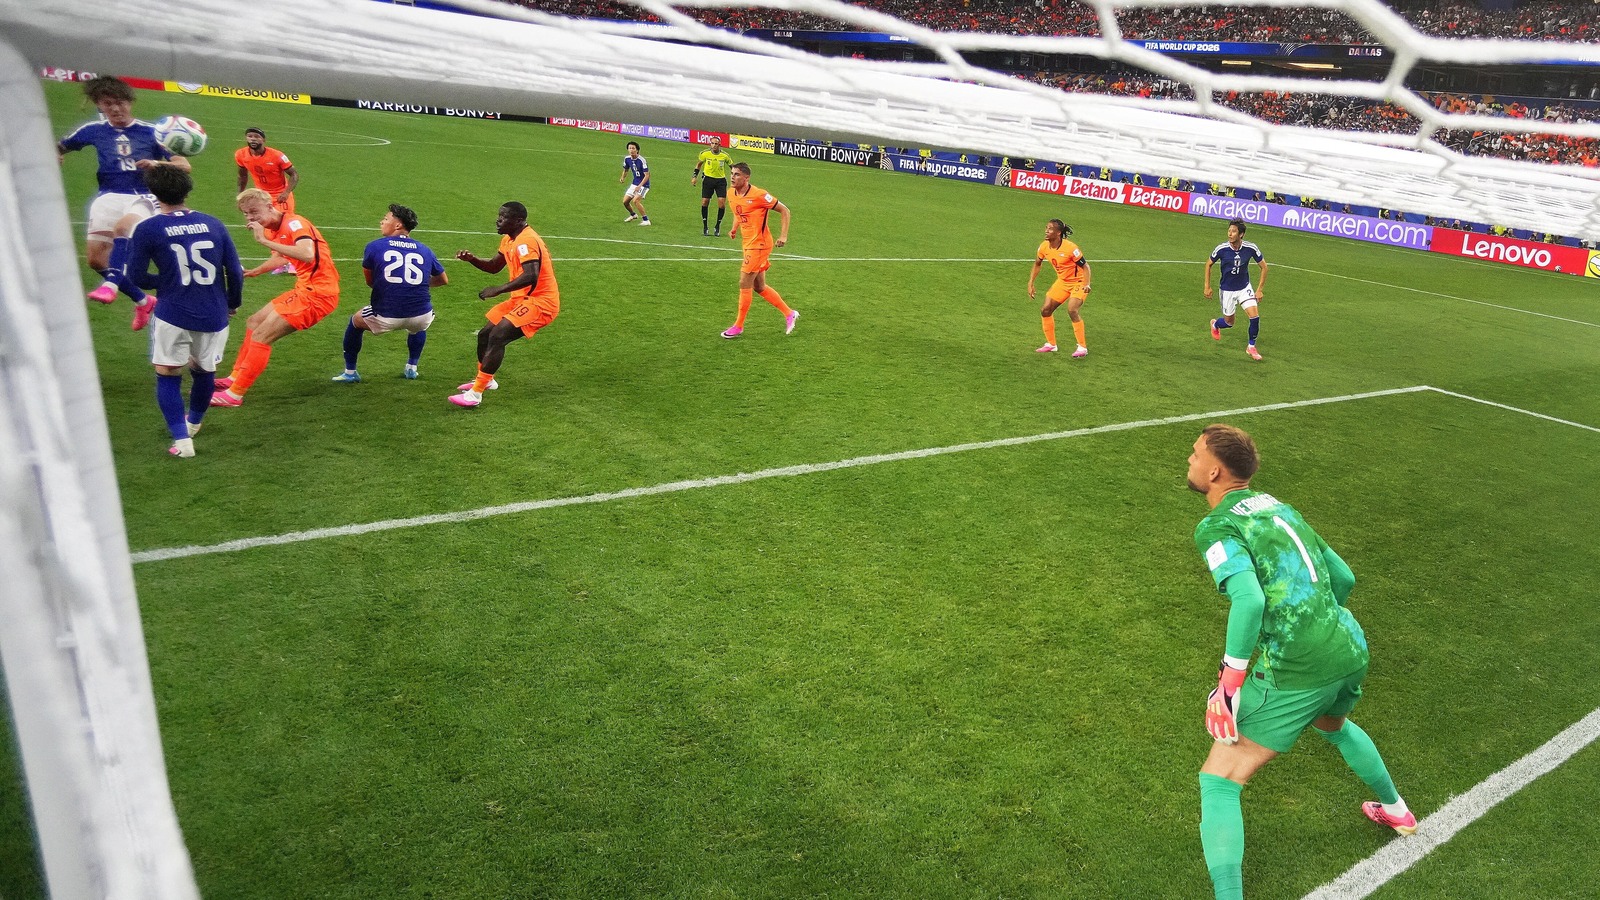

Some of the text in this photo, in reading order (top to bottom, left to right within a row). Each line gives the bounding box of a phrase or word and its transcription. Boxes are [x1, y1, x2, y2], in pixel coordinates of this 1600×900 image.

[1348, 48, 1382, 56] DALLAS
[740, 138, 774, 150] mercado libre
[780, 142, 871, 165] MARRIOTT BONVOY
[900, 159, 985, 179] FIFA WRLD CUP 2026
[1016, 172, 1059, 192] Betano
[1070, 179, 1117, 200] Betano
[1130, 187, 1182, 210] Betano
[1206, 196, 1268, 222] kraken
[165, 223, 210, 237] KAMADA
[1300, 212, 1427, 247] kraken.com
[1462, 234, 1551, 267] Lenovo
[170, 241, 216, 286] 15
[384, 250, 424, 285] 26
[512, 304, 529, 317] 19
[1273, 515, 1318, 582] 1
